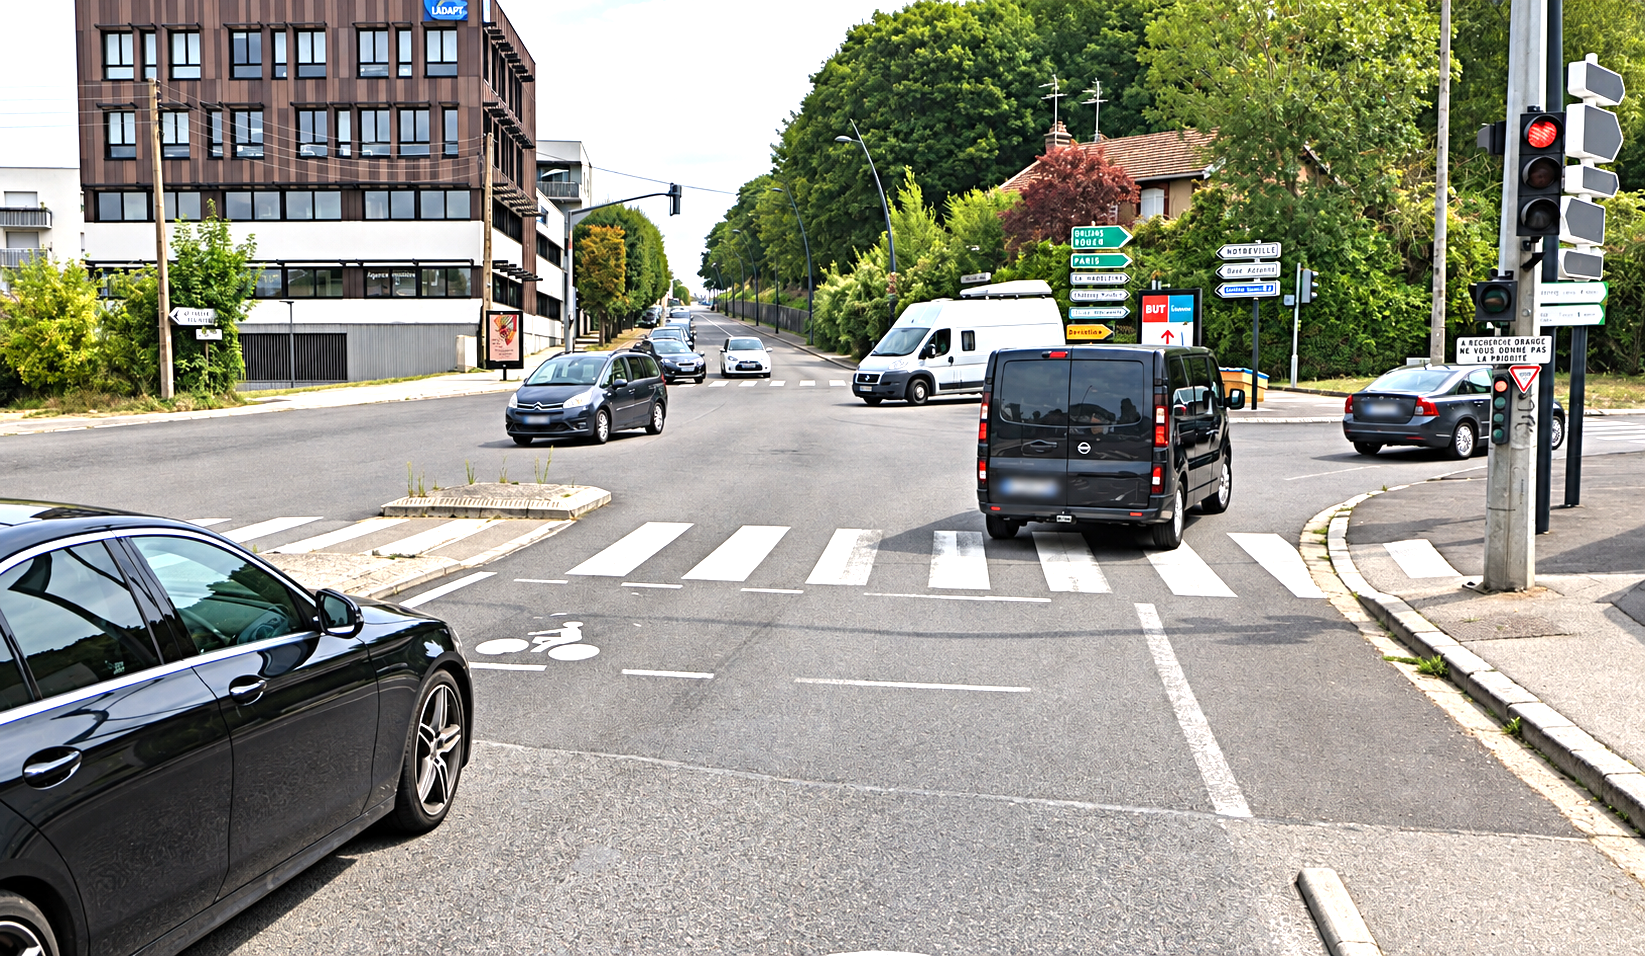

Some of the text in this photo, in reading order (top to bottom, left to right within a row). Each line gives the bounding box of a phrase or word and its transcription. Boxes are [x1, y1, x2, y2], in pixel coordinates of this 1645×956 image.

[1074, 257, 1100, 265] PARIS
[1145, 304, 1166, 314] BUT
[1514, 337, 1546, 346] ORANGE
[1474, 346, 1495, 354] VOUS
[1476, 355, 1487, 363] LA
